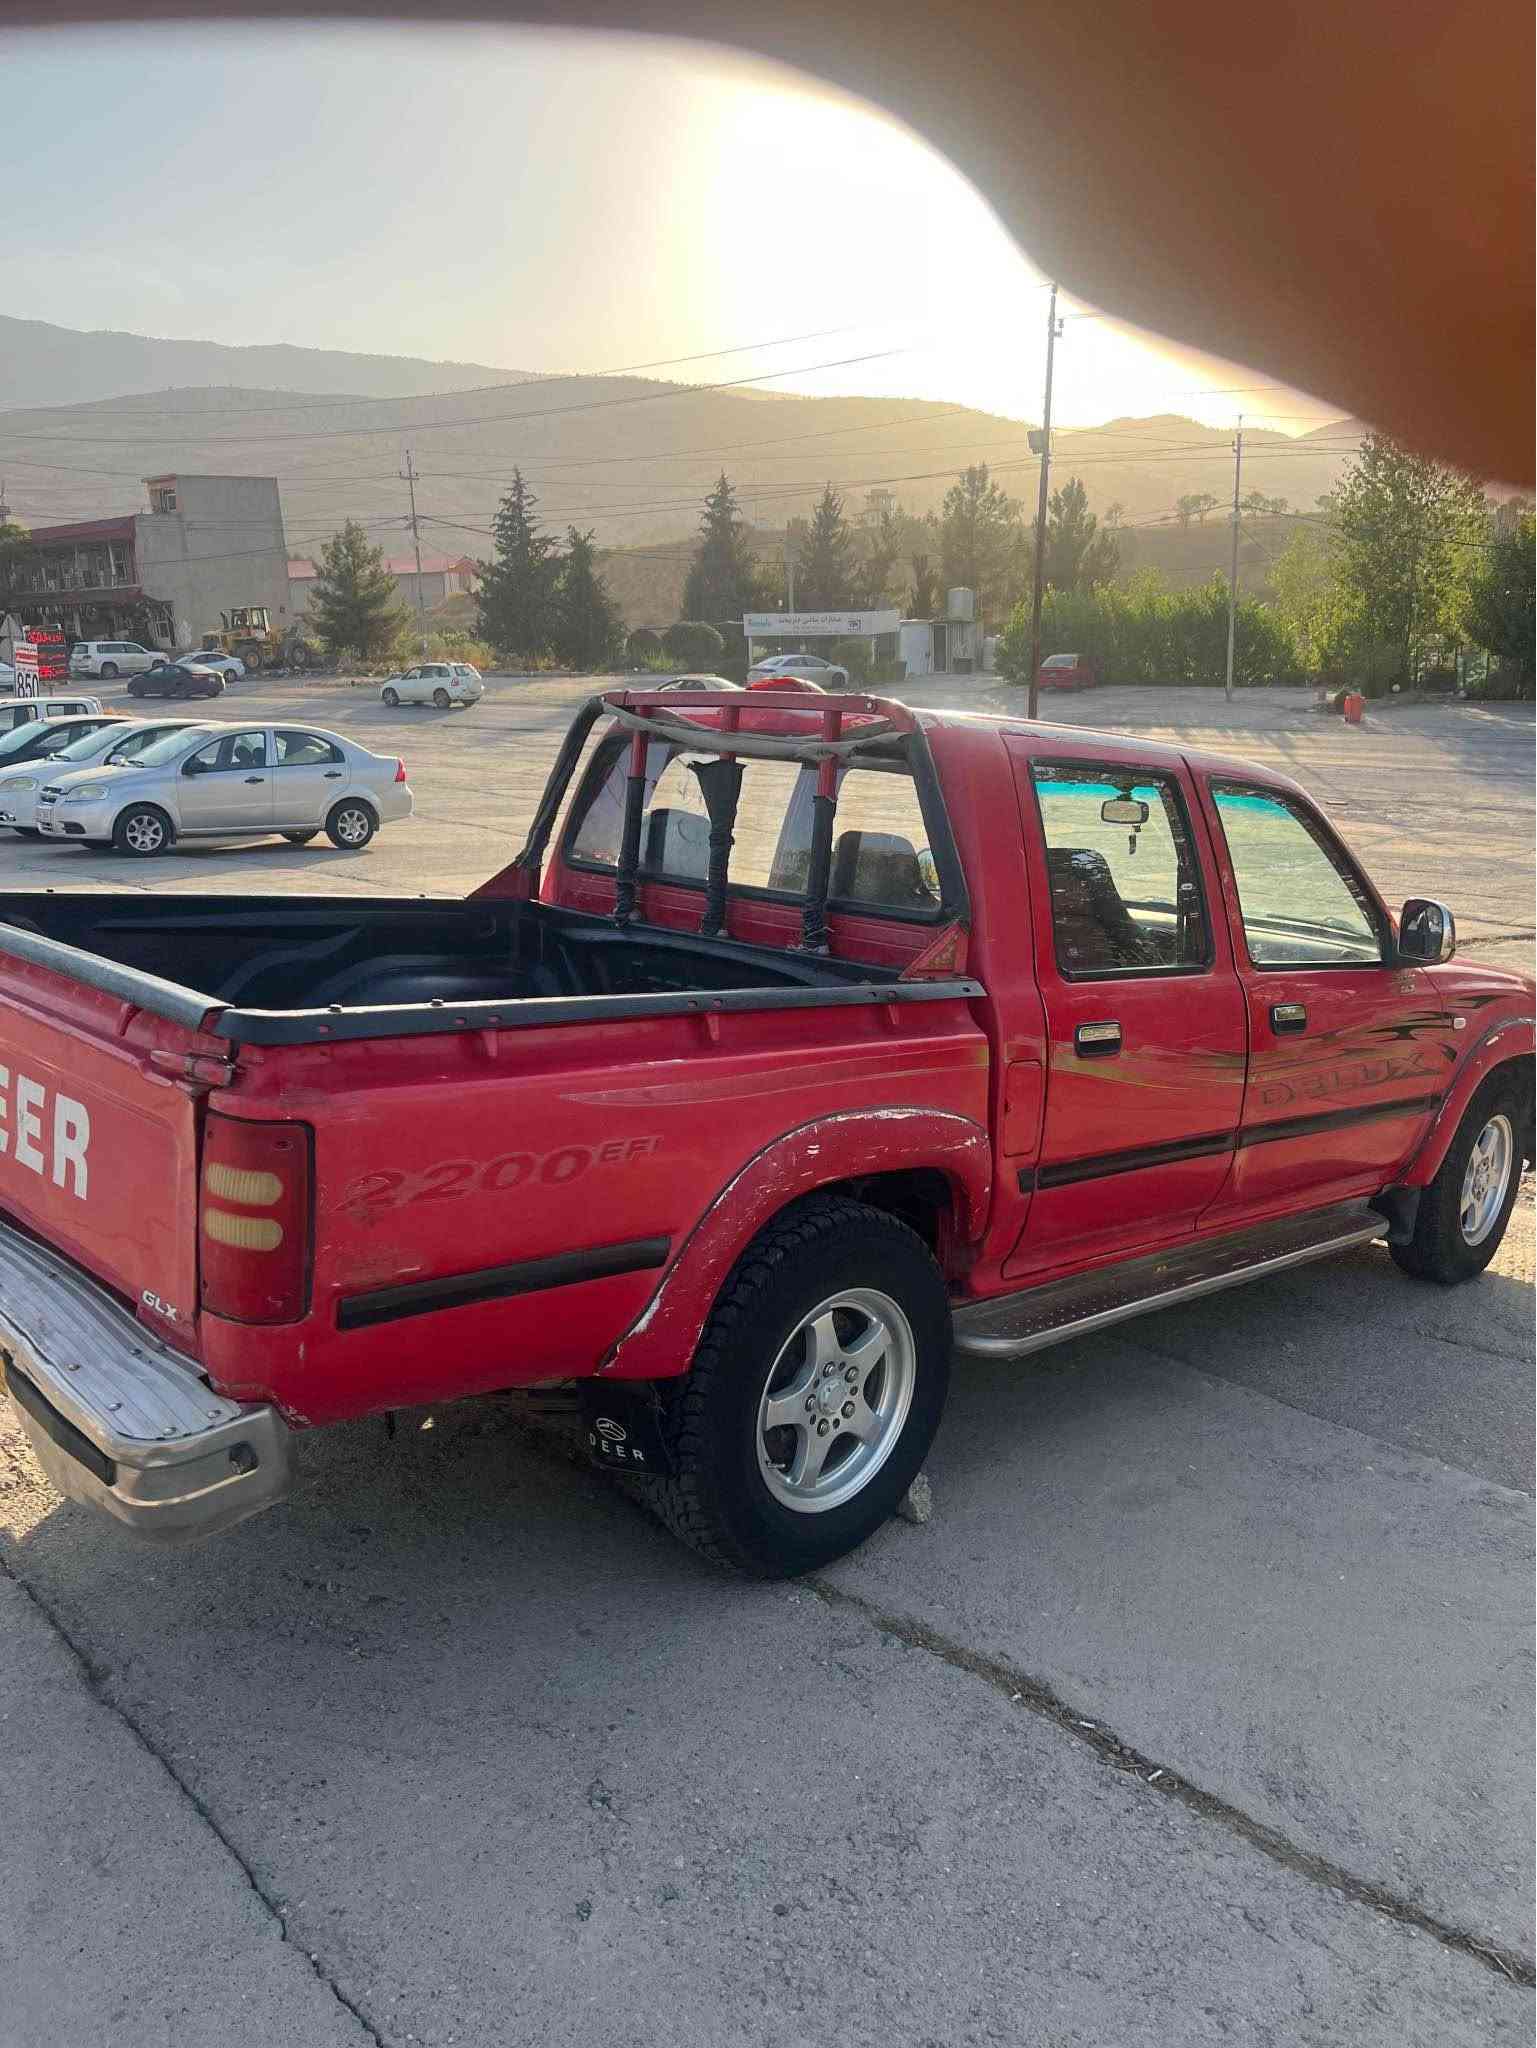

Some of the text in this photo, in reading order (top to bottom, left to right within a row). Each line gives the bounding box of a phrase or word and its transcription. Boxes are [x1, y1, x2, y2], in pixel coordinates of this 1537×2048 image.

[330, 1135, 663, 1214] 2200 EFI
[143, 1290, 177, 1321] GLX
